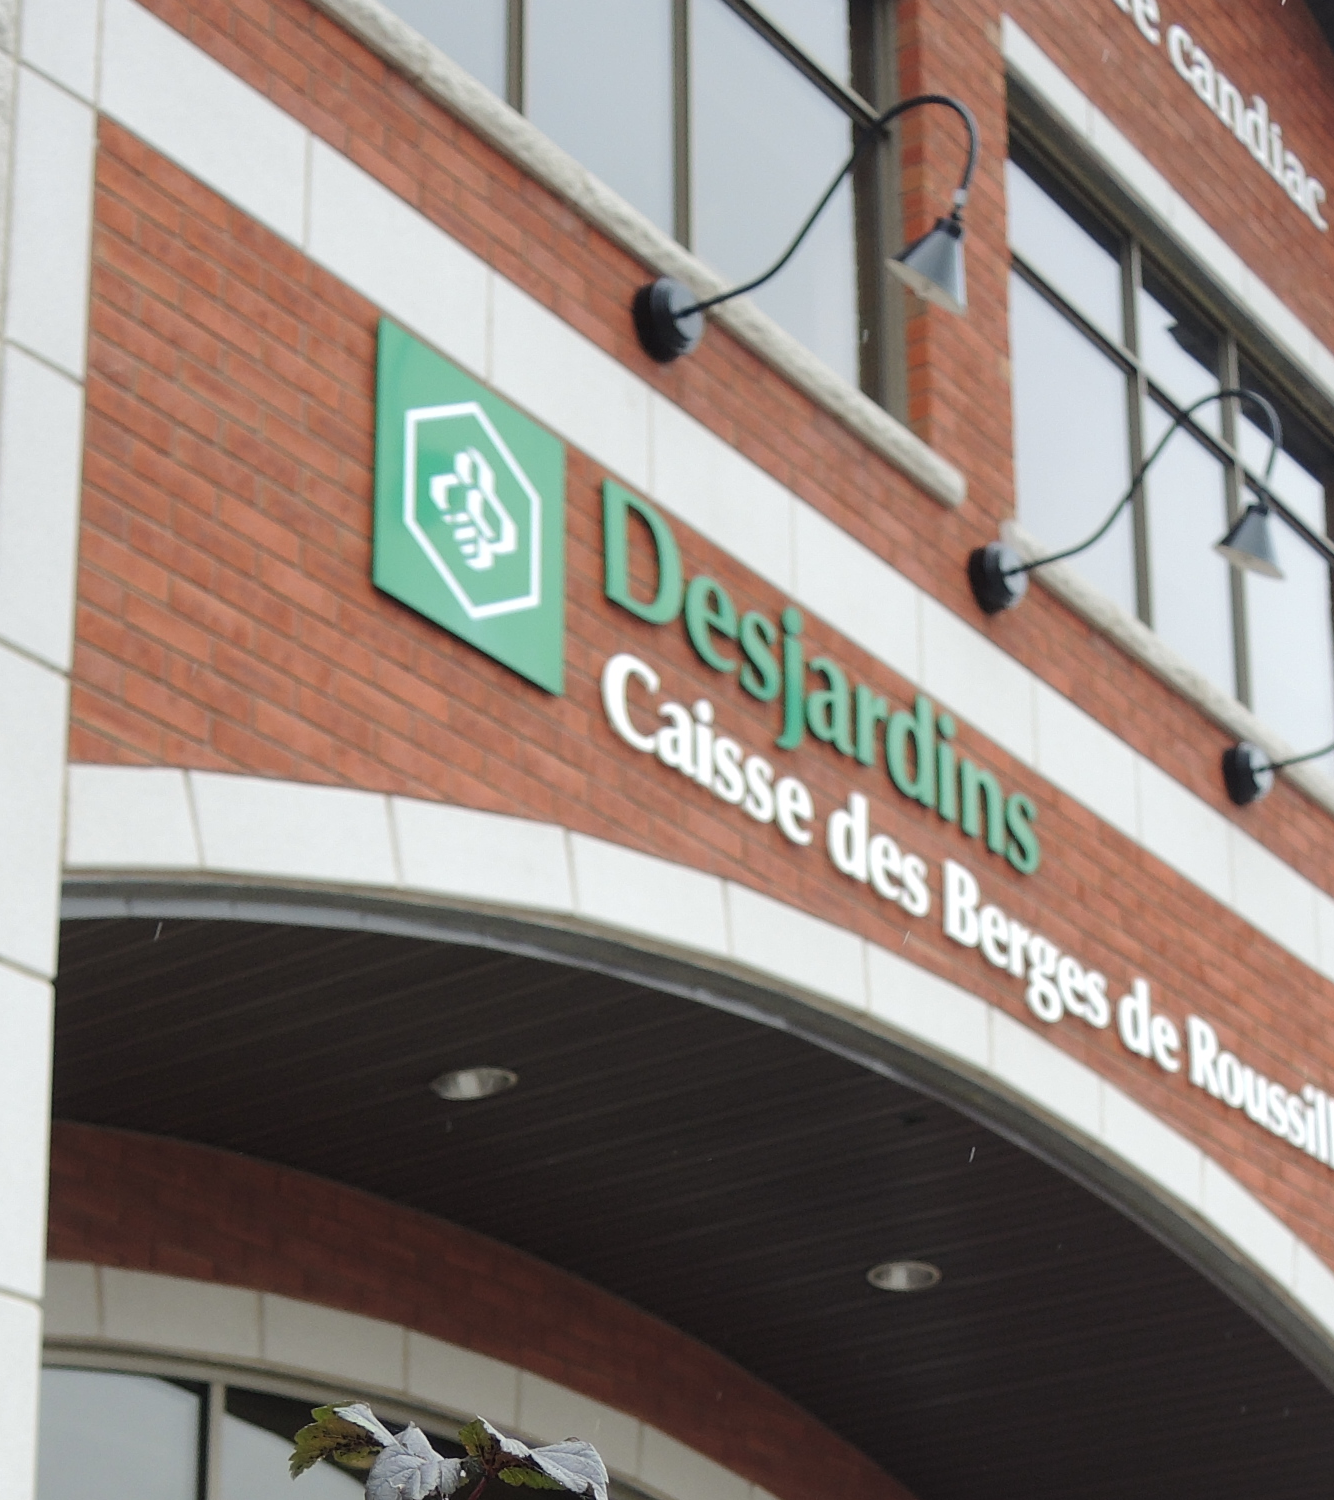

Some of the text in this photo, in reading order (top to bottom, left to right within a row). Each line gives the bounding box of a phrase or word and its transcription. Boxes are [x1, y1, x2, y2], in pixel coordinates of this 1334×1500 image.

[1167, 25, 1328, 232] Candiac
[601, 478, 1041, 874] Desjardins
[602, 652, 814, 845] Caisse
[827, 792, 930, 918] des
[941, 858, 1110, 1028] Berges
[1118, 976, 1179, 1074] de
